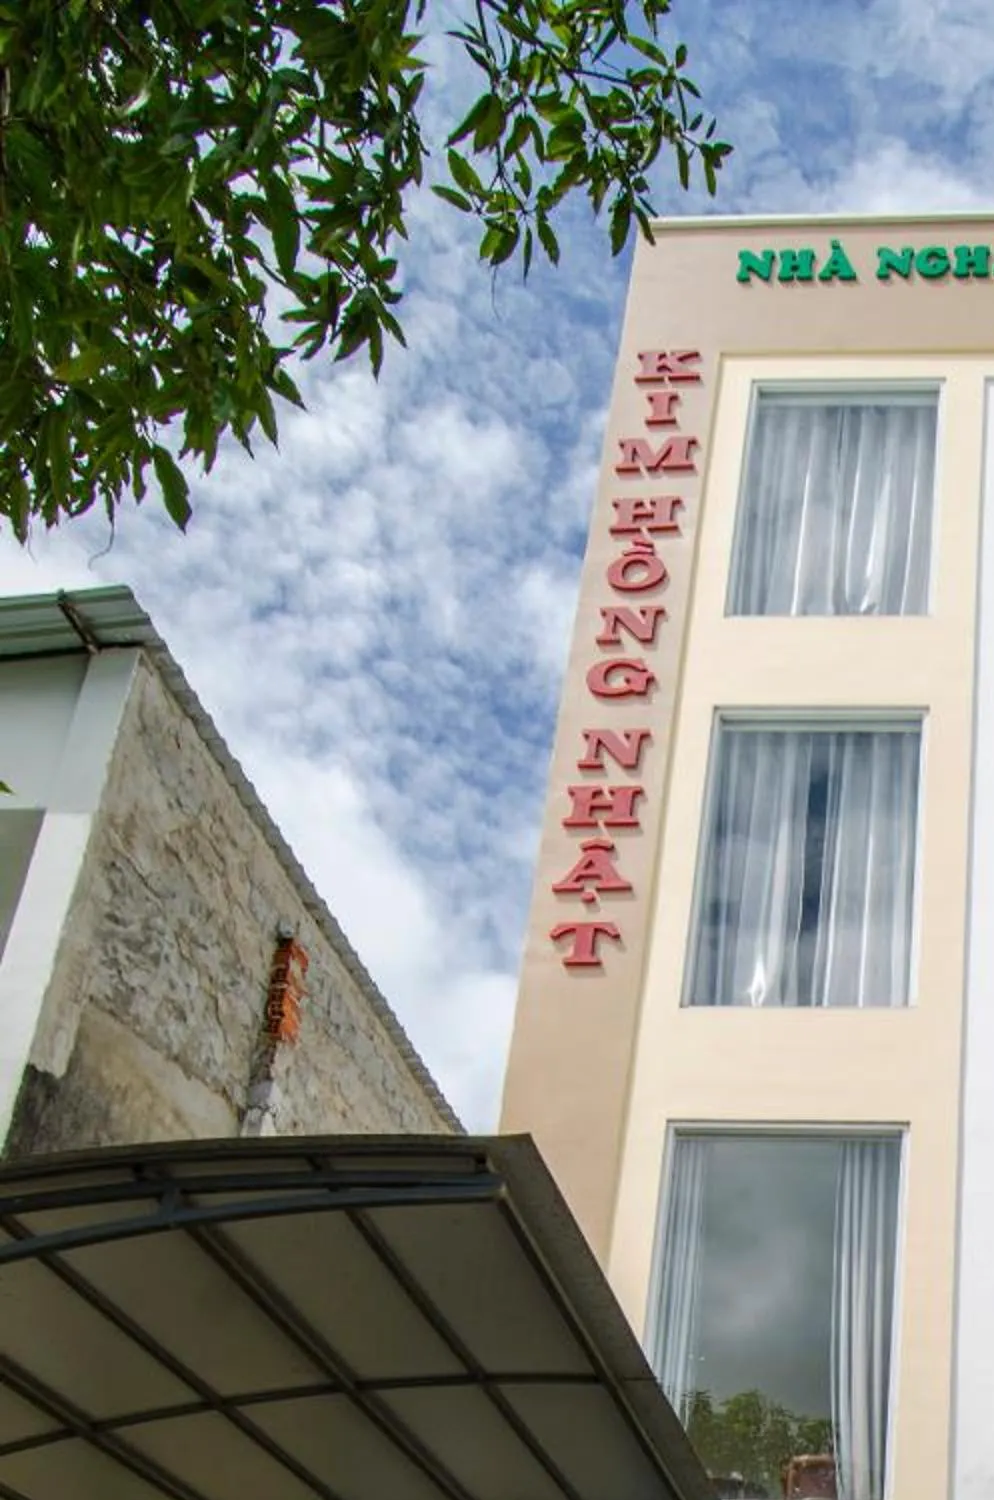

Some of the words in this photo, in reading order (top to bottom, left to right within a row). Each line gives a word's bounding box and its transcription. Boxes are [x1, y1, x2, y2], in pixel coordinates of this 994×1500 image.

[737, 239, 857, 283] NHÀ
[615, 351, 702, 475] KIM
[550, 728, 652, 967] NHẬT
